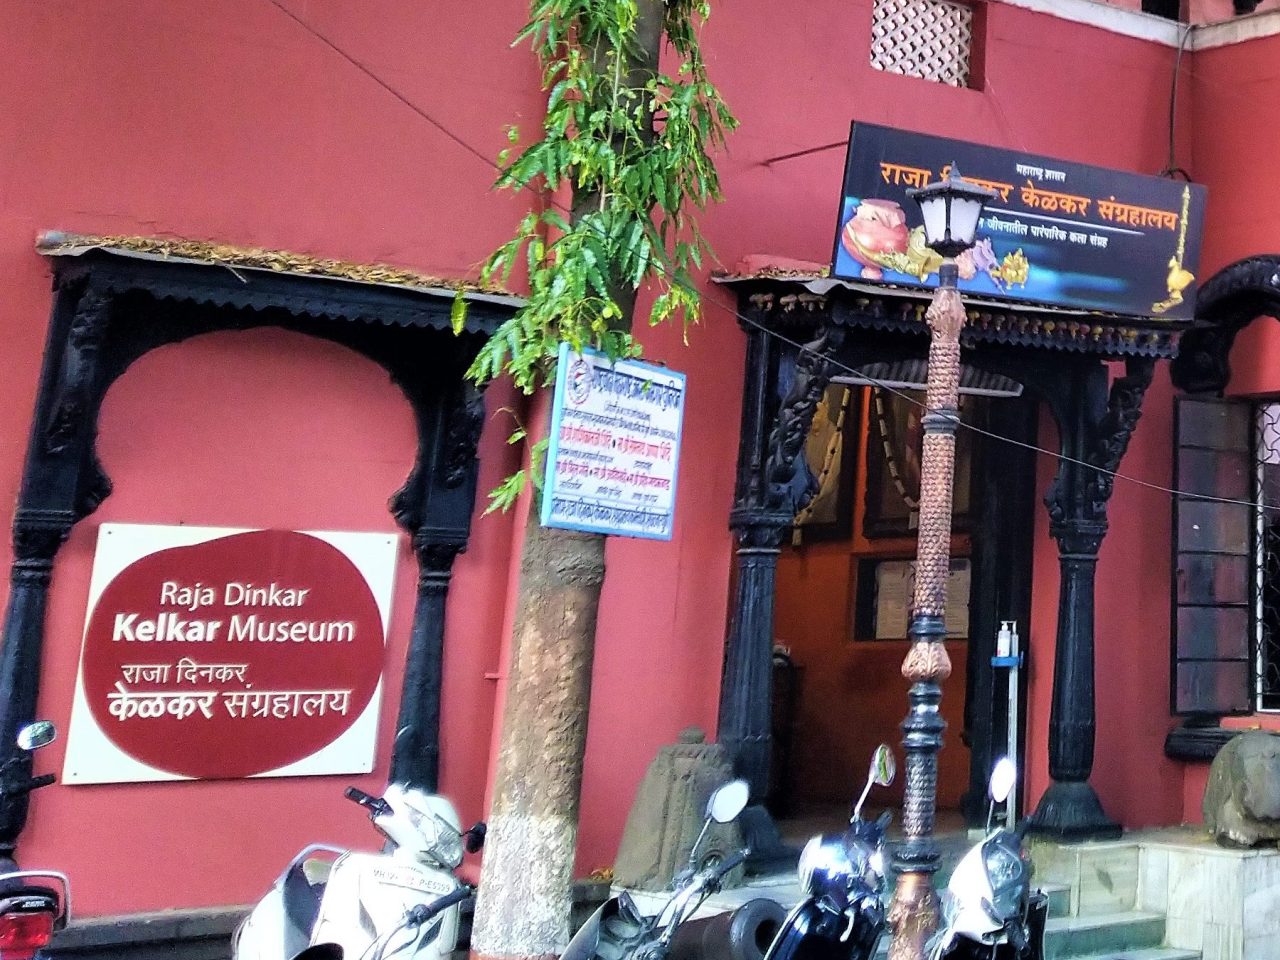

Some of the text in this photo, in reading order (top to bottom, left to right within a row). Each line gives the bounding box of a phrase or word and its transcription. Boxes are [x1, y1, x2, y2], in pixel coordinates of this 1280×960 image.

[880, 162, 931, 188] राजा
[1021, 180, 1091, 217] केळकर
[1097, 195, 1178, 231] संग्रहालय
[160, 581, 309, 611] Raja Dinkar
[112, 613, 355, 643] Kelkar Museum
[121, 657, 248, 684] राजा दिनकर
[107, 681, 354, 721] केळकर संग्रहालय
